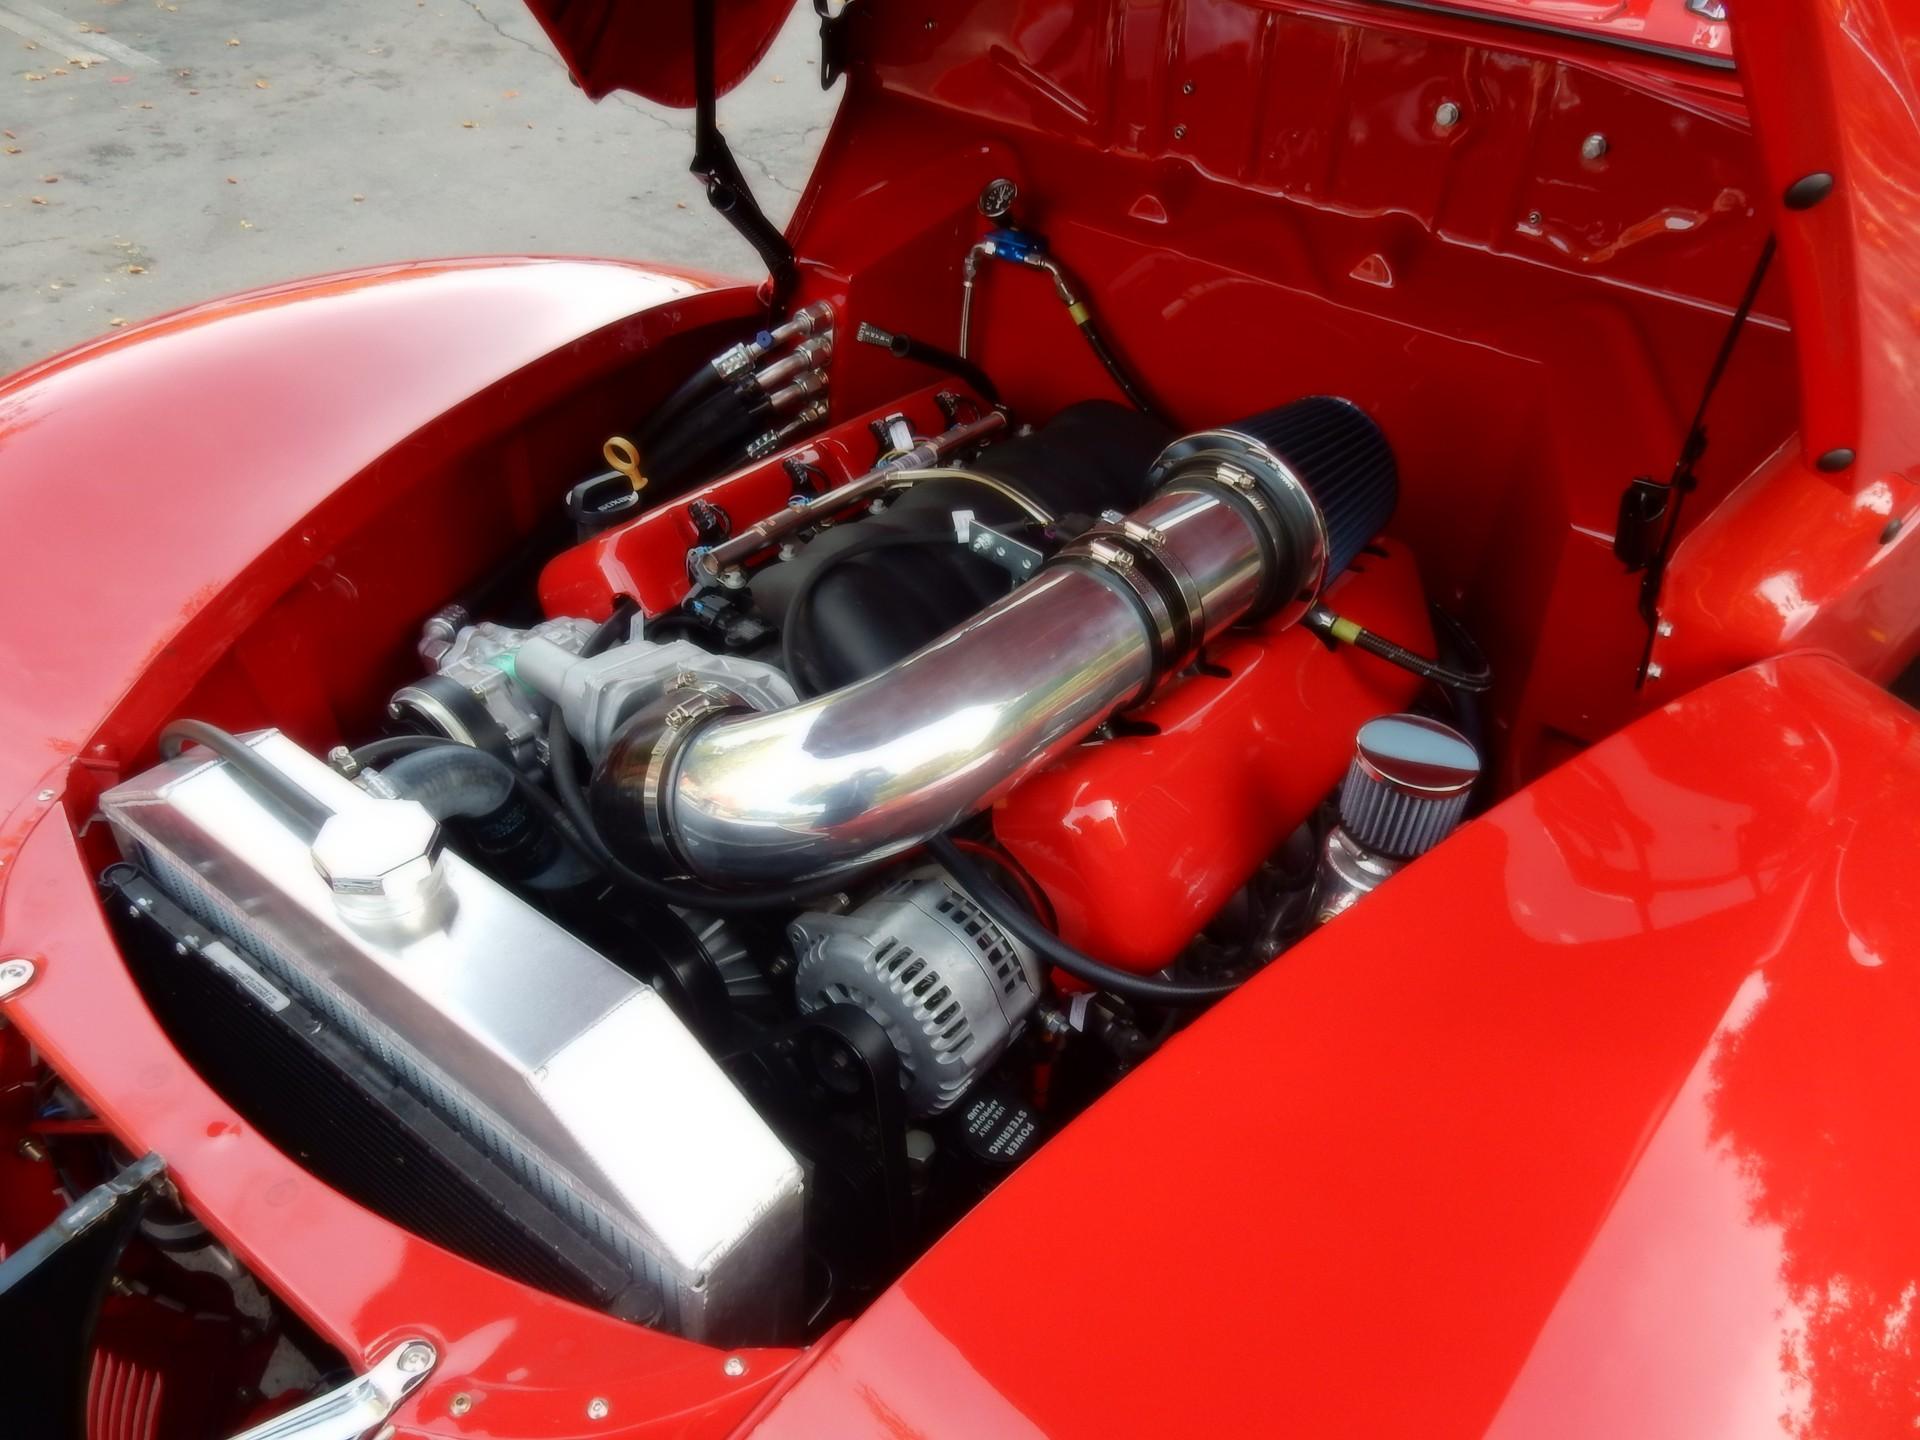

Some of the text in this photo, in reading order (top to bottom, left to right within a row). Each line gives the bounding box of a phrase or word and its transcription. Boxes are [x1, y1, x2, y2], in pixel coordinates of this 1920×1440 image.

[968, 1101, 985, 1120] FLUID
[969, 1099, 998, 1133] APPROVED
[979, 1106, 1006, 1137] USE ONLY
[988, 1110, 1028, 1154] STEERING
[1005, 1123, 1035, 1155] POWER
